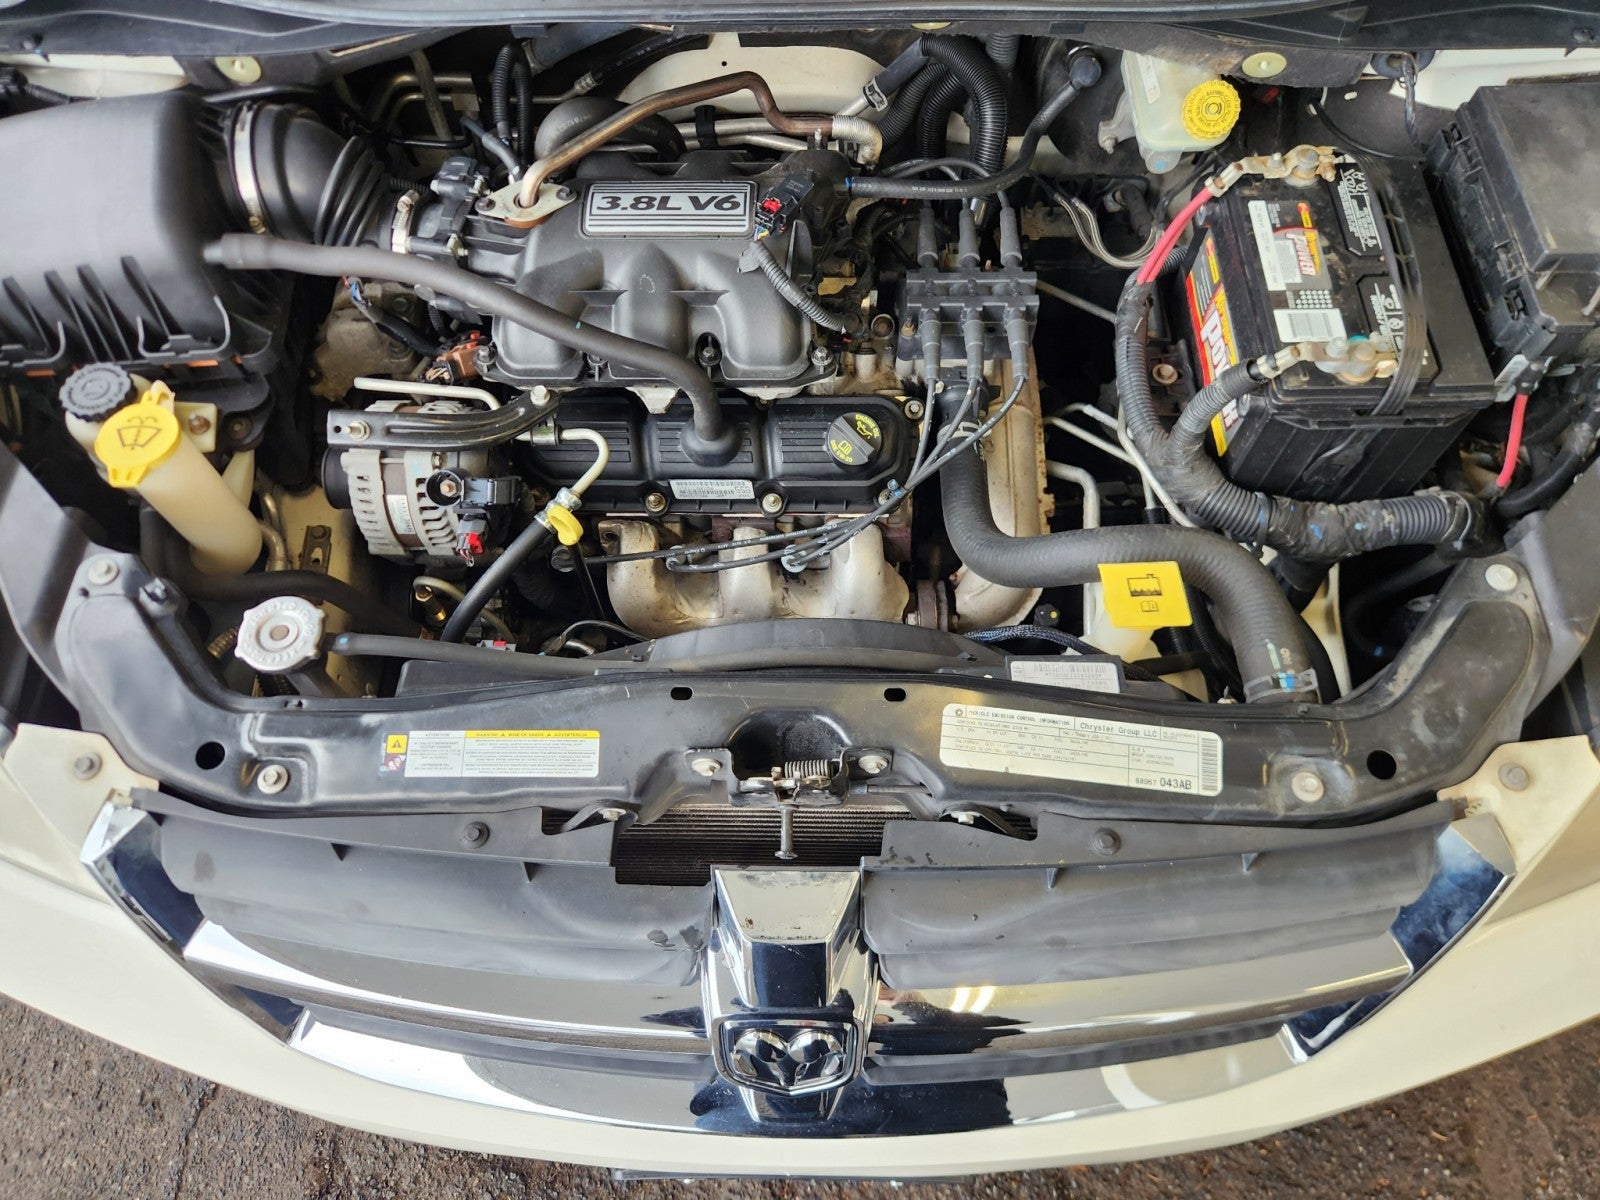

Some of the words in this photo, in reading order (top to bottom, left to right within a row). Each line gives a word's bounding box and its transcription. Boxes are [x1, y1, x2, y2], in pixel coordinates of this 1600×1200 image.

[596, 195, 682, 211] 3.8L
[688, 195, 741, 211] V6
[855, 413, 876, 430] ENGINE
[872, 427, 880, 439] OIL
[991, 712, 1015, 720] EMISSION
[1016, 714, 1036, 722] CONTROL
[1039, 716, 1070, 726] INFORMATION
[1079, 721, 1115, 733] Chrysler
[1118, 726, 1141, 737] Group
[1143, 730, 1158, 738] LLC
[1159, 777, 1192, 790] 043AB
